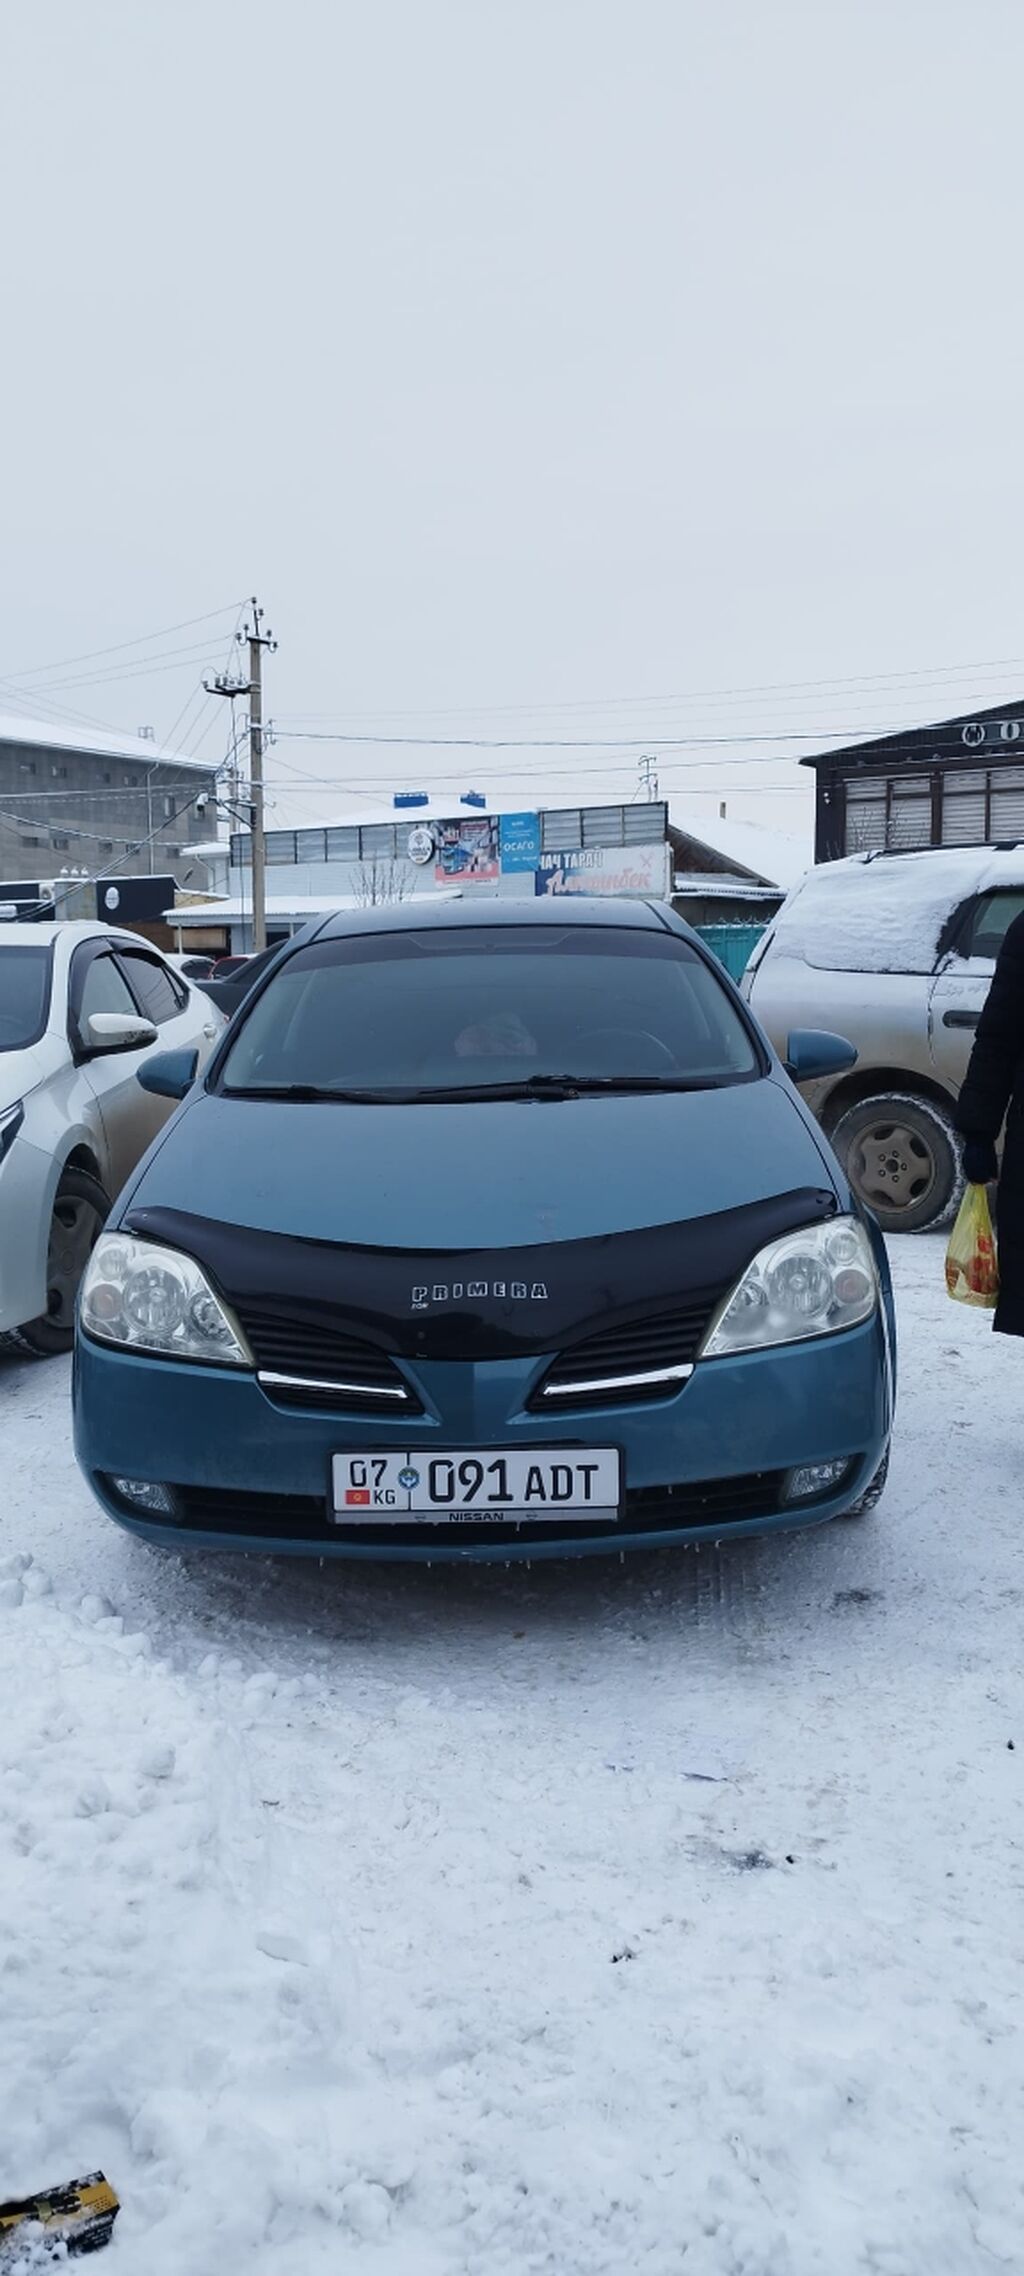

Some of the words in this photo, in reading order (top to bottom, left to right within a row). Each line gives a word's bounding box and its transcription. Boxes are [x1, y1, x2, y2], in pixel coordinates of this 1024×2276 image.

[504, 840, 534, 852] ОСАГО
[411, 1281, 549, 1302] PRIMERA
[349, 1460, 388, 1487] 07
[428, 1459, 513, 1503] 091
[523, 1464, 599, 1501] ADT
[374, 1489, 396, 1505] KG
[448, 1512, 504, 1521] NISSAN
